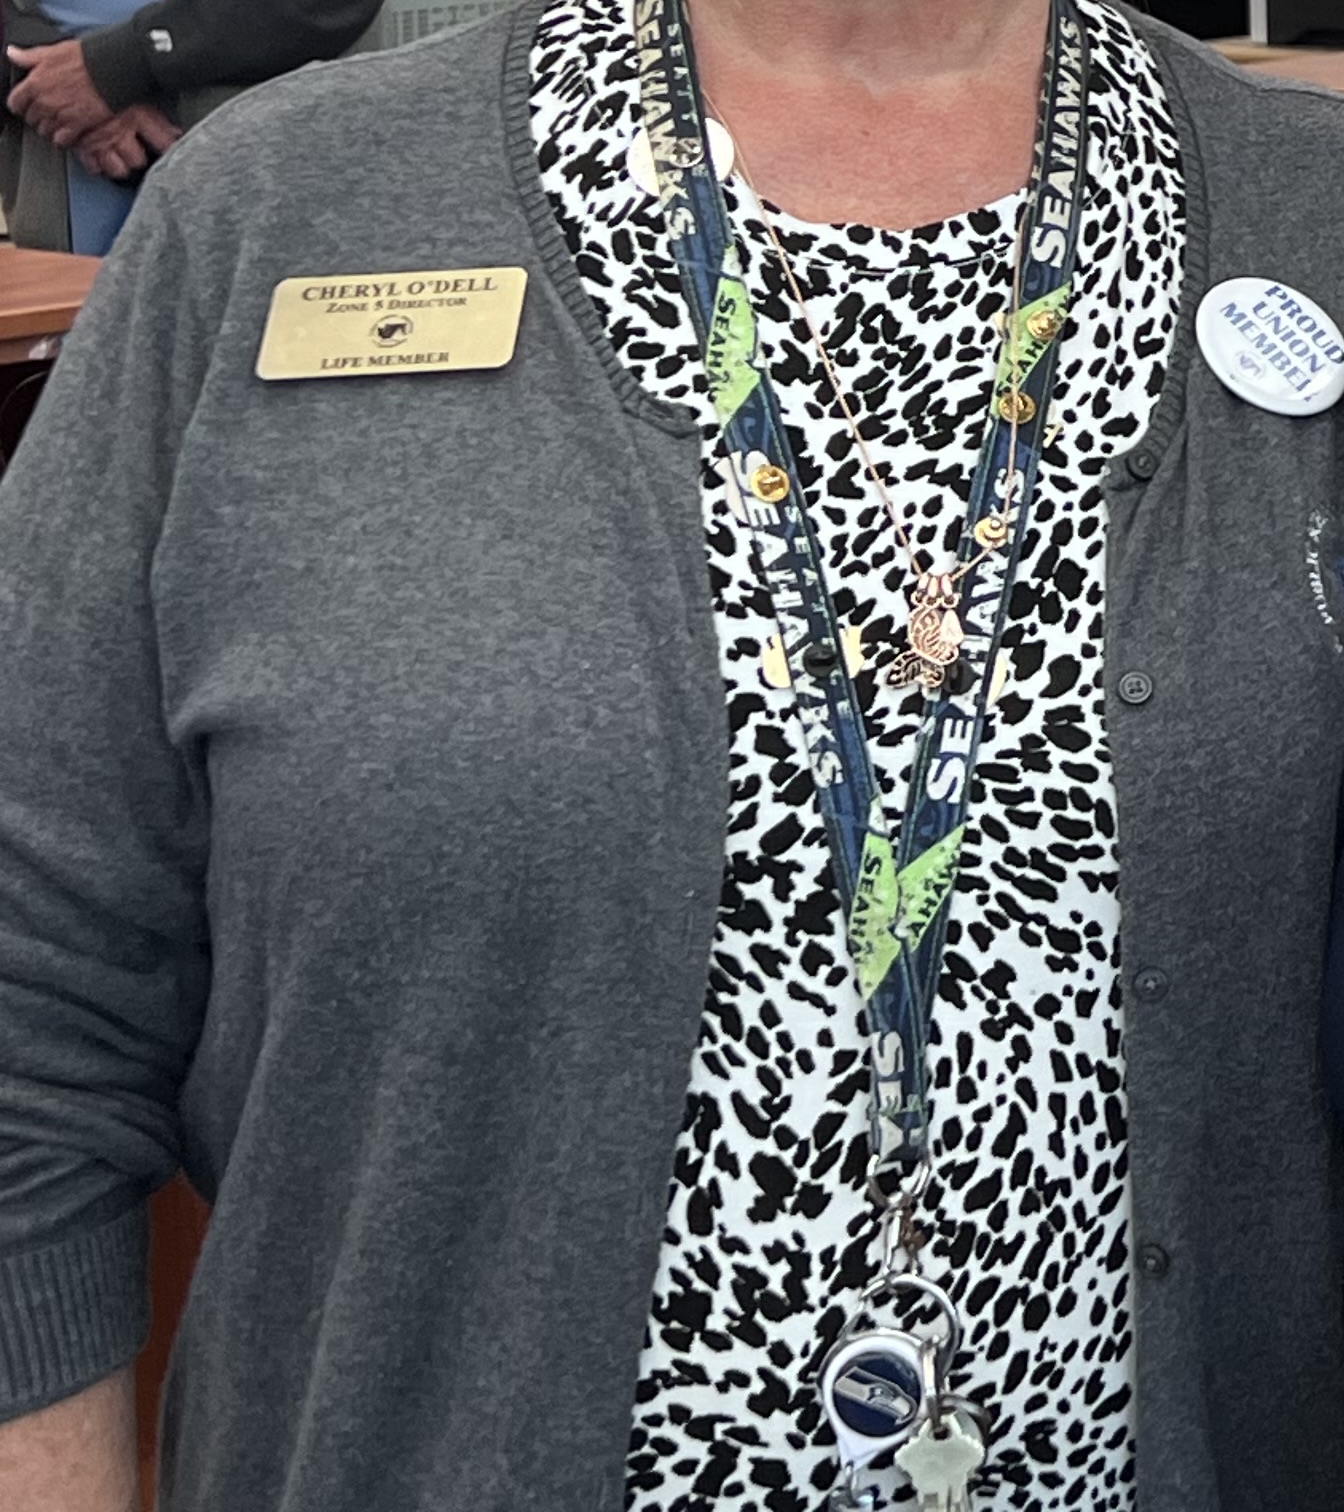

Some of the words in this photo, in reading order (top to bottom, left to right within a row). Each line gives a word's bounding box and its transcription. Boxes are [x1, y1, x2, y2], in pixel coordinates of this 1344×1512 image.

[1030, 16, 1081, 269] SEAHAWKS
[302, 281, 402, 302] CHERYL
[407, 276, 498, 296] O'DELL
[320, 356, 363, 370] LIFE
[367, 351, 450, 367] MEMBER
[1252, 300, 1327, 373] UNION
